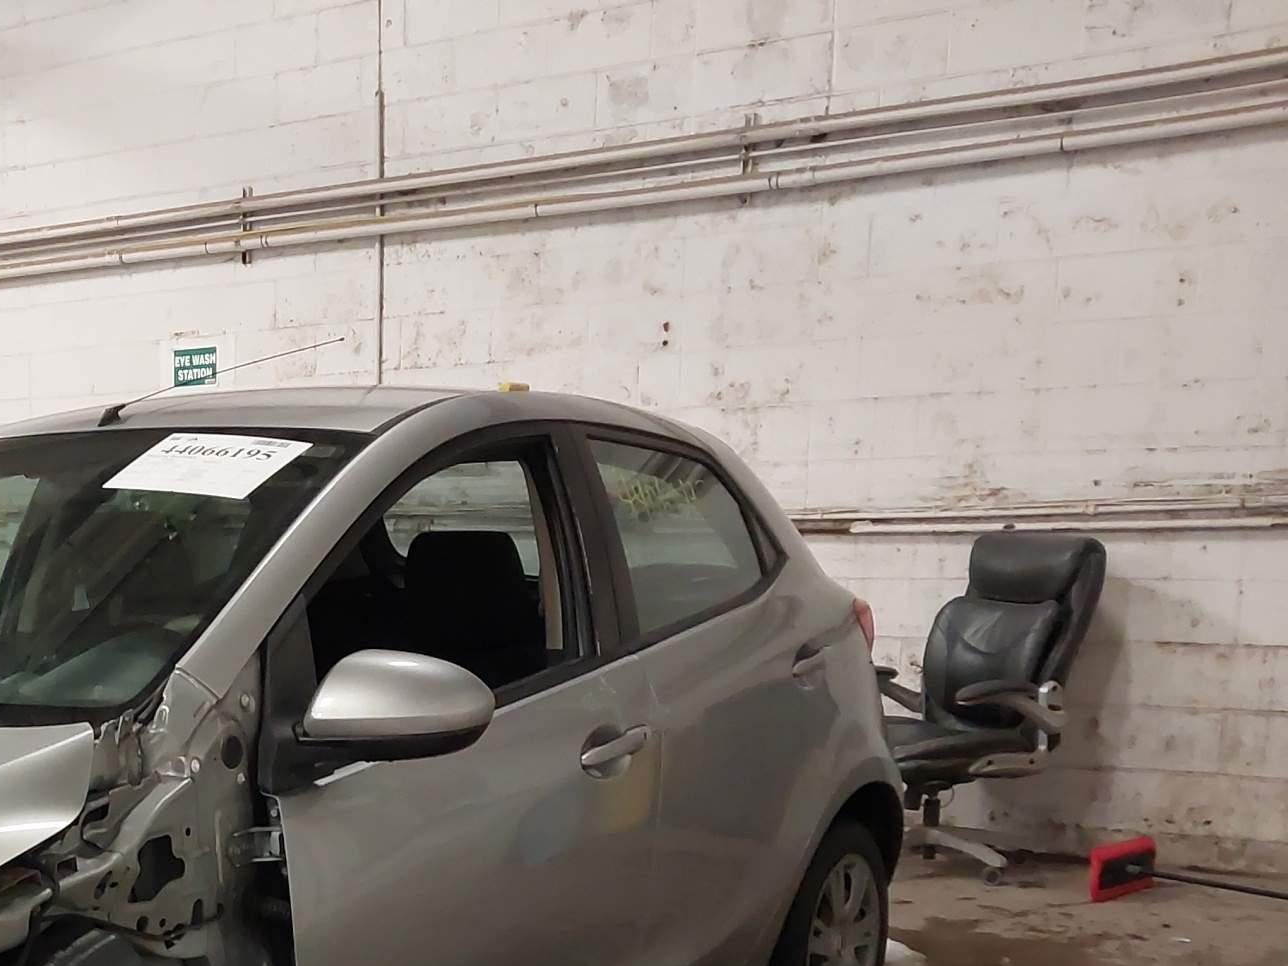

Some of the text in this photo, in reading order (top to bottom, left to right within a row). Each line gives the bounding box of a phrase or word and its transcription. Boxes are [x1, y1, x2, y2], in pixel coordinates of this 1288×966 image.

[175, 352, 216, 367] EYE WASH
[177, 367, 213, 381] STATION
[161, 445, 277, 460] 44066195
